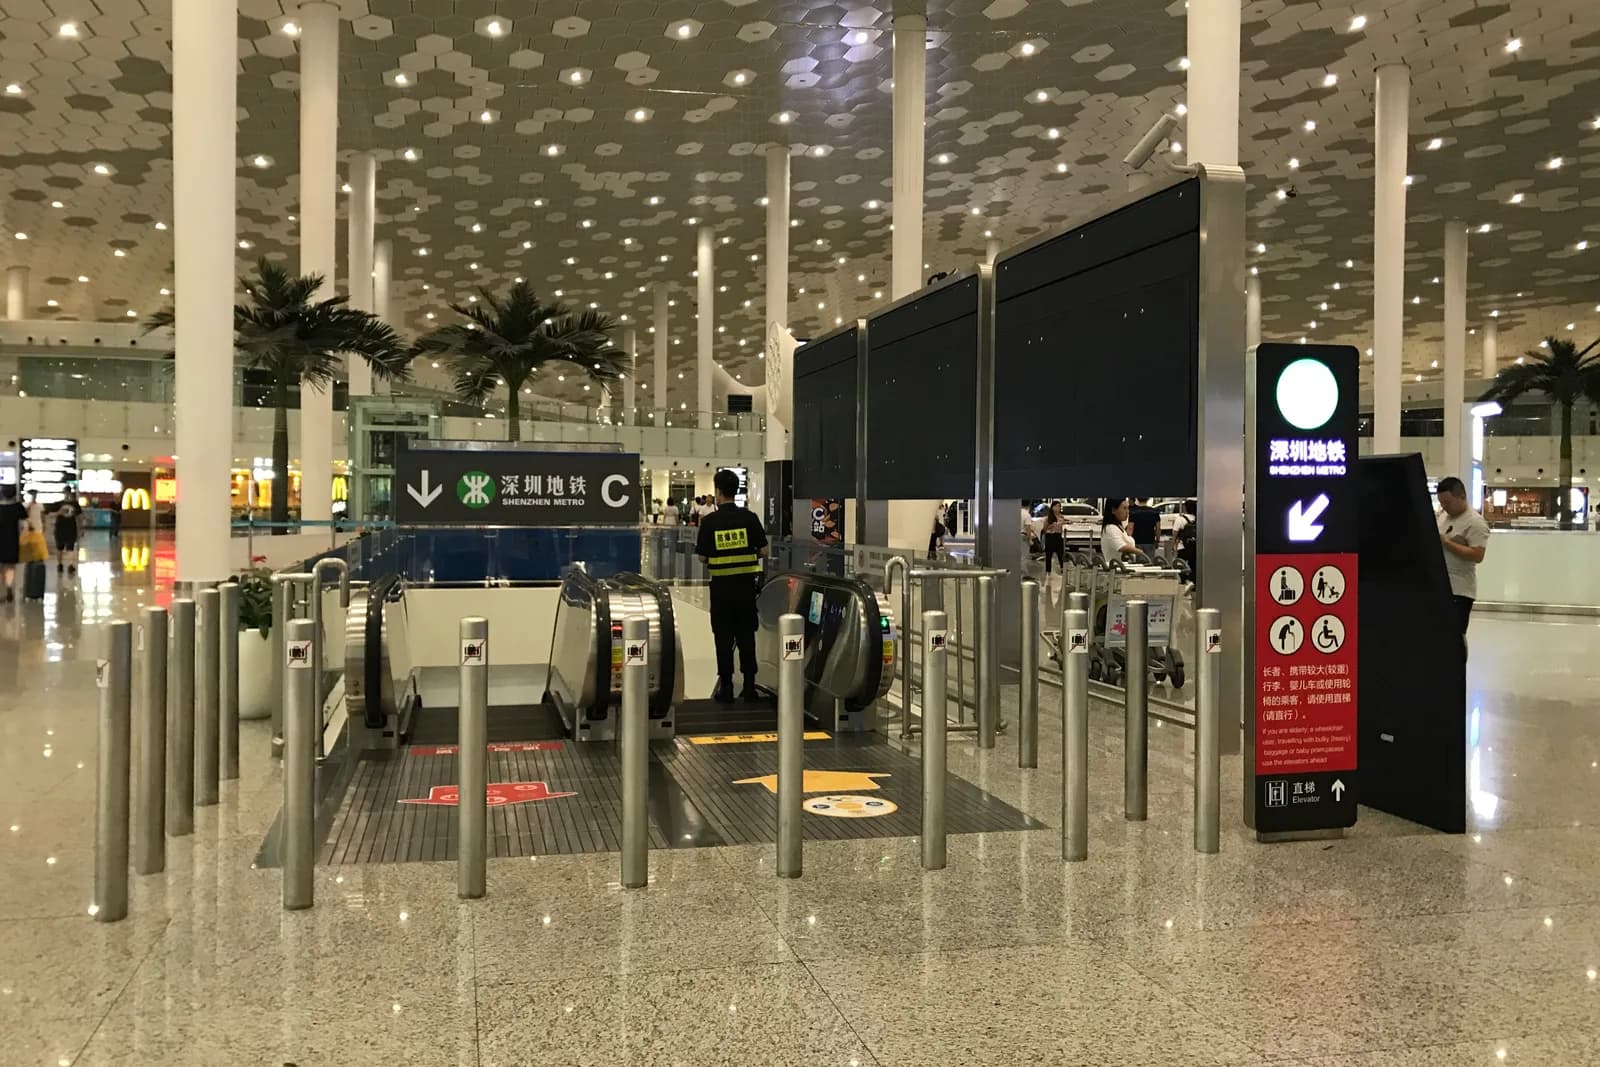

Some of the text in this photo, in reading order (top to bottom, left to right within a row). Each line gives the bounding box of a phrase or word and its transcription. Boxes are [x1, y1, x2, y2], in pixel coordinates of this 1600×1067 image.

[1269, 439, 1346, 463] 深圳地铁
[501, 475, 587, 496] 深圳地铁
[601, 474, 630, 508] C
[502, 498, 585, 506] SHENZHEN METRO
[813, 507, 825, 521] C
[1293, 781, 1315, 794] 直梯
[1292, 796, 1320, 804] Elevator
